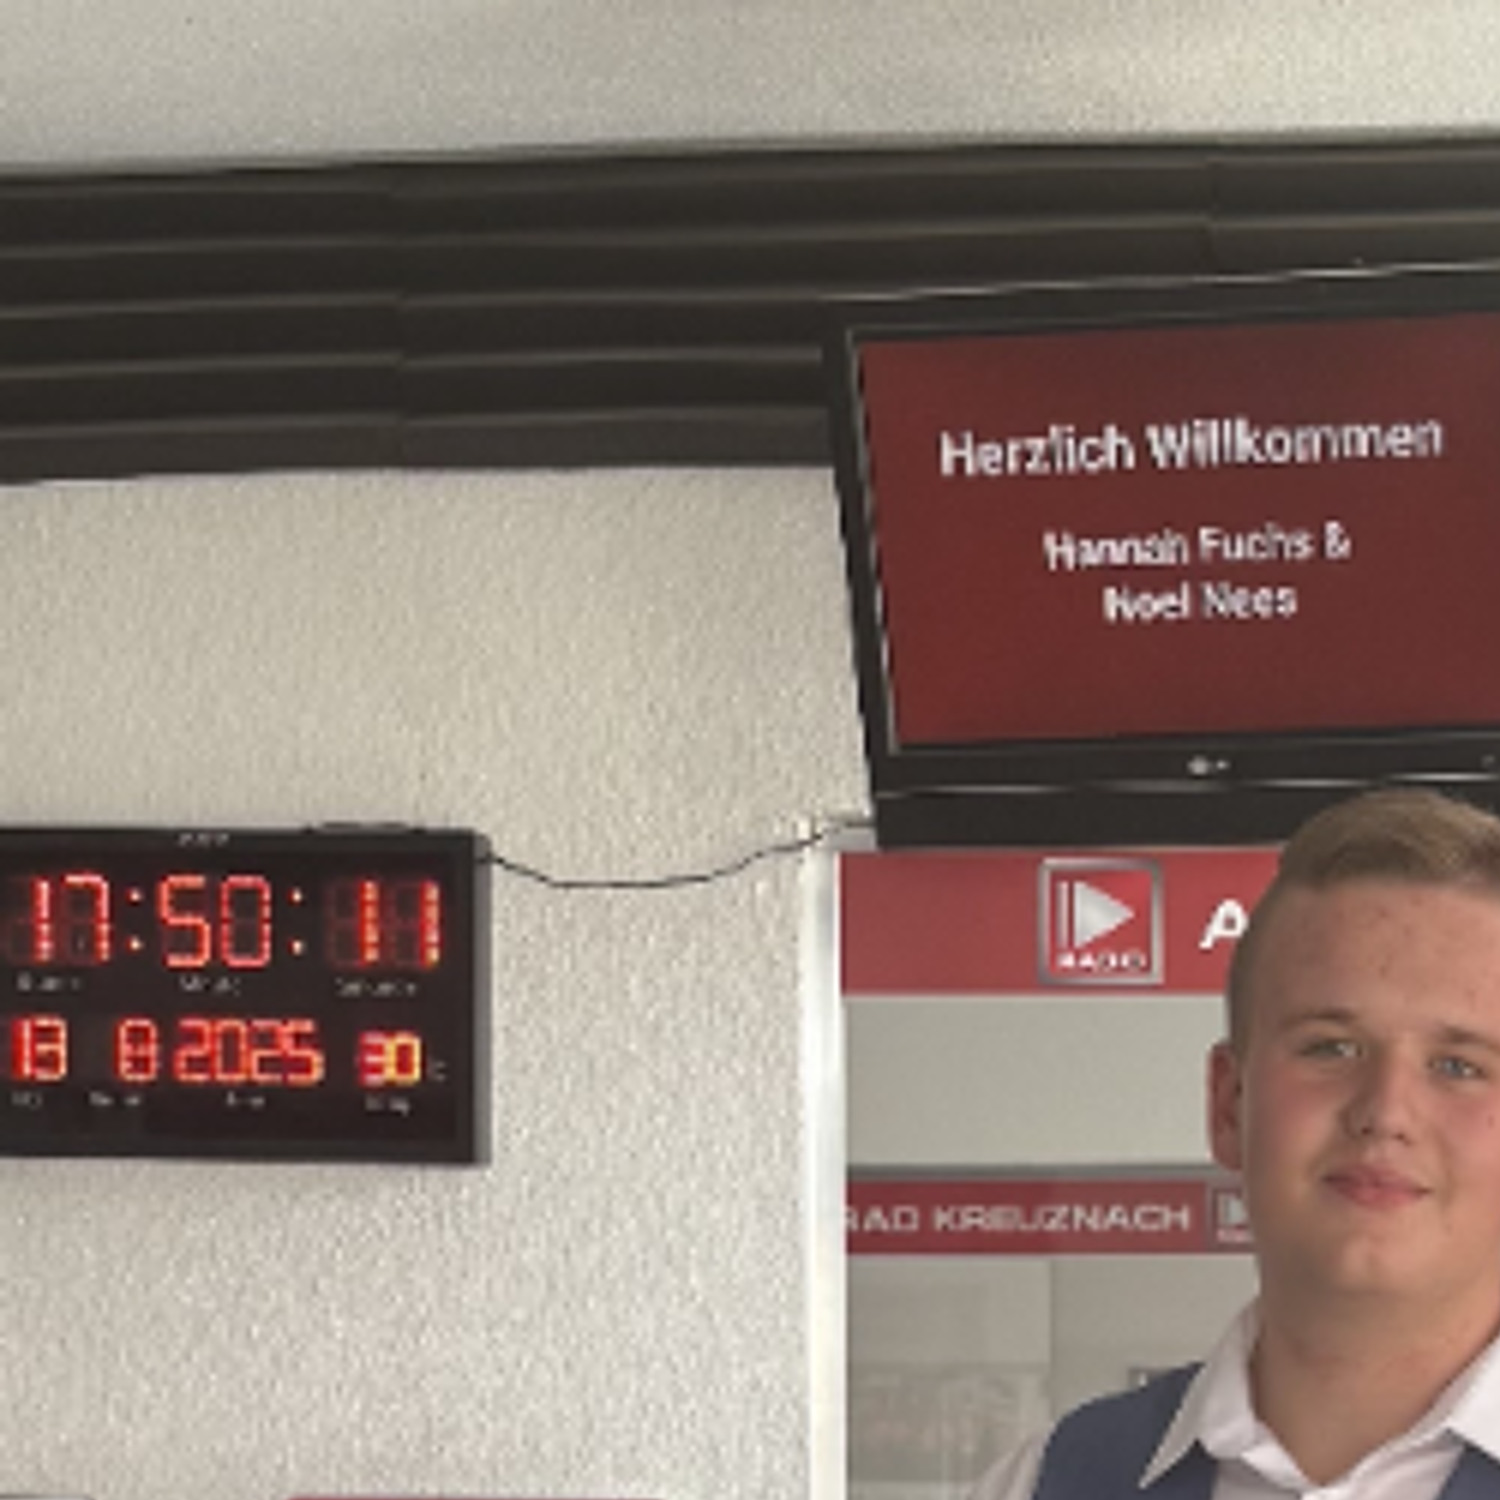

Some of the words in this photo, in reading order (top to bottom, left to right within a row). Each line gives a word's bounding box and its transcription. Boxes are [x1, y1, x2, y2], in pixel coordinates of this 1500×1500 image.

[939, 423, 1136, 477] Herzlich
[1146, 417, 1443, 471] Willkommen
[1043, 529, 1190, 572] Hannah
[1199, 522, 1312, 563] Fuchs
[1324, 520, 1352, 561] &
[1103, 580, 1190, 623] Noel
[174, 1018, 324, 1083] 2025
[358, 1032, 422, 1085] 30
